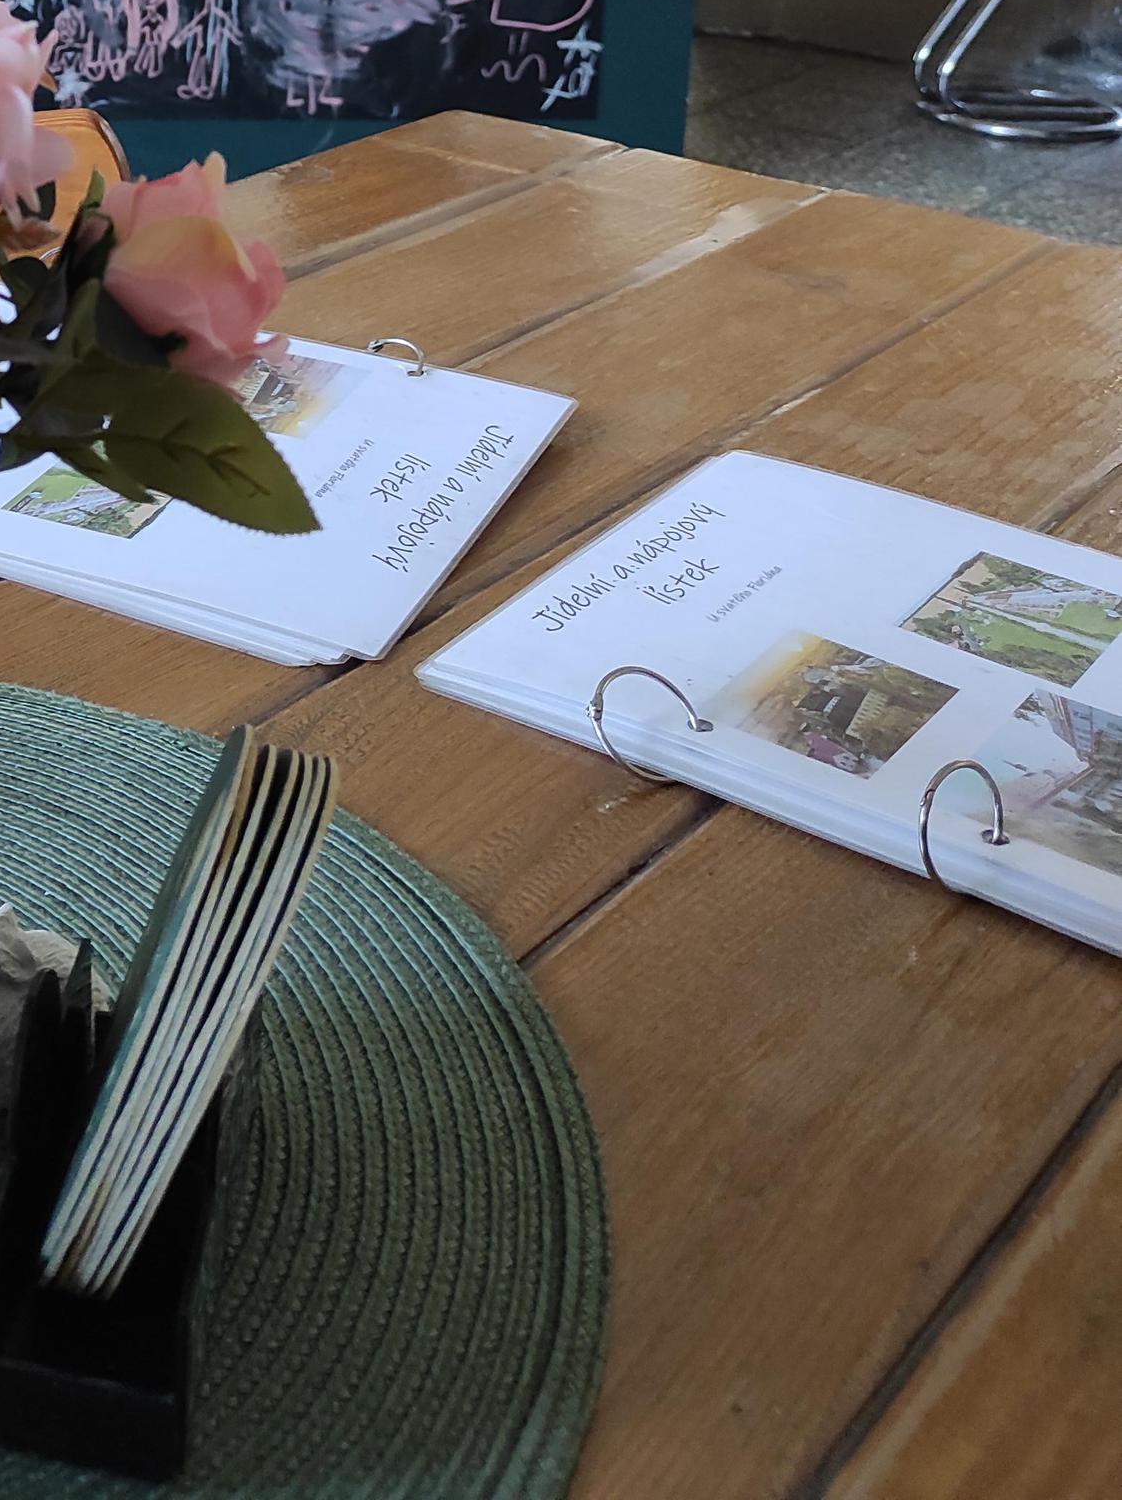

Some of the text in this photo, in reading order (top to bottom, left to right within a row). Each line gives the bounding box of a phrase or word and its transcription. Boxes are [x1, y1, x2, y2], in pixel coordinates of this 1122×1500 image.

[369, 453, 433, 503] lístek
[371, 424, 515, 573] Jídelní a nápojový
[531, 502, 727, 632] Jídelní a nápojový
[642, 557, 720, 605] lístek
